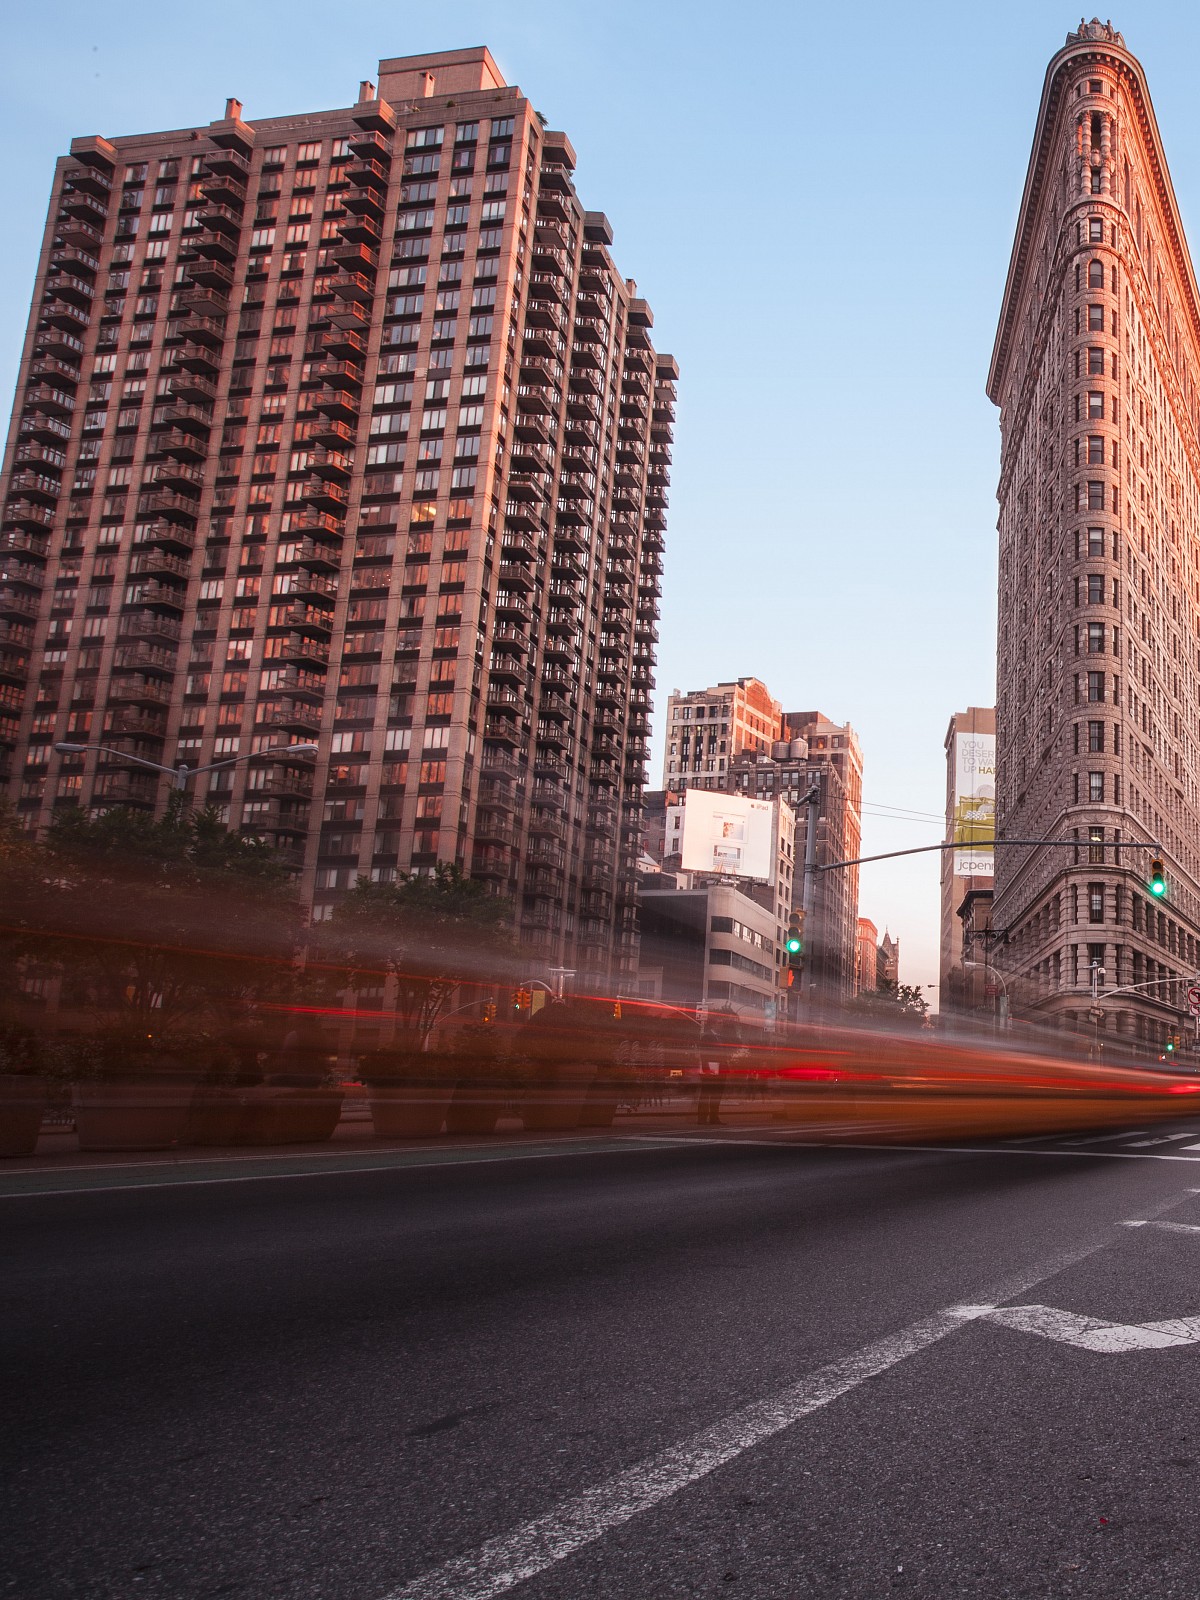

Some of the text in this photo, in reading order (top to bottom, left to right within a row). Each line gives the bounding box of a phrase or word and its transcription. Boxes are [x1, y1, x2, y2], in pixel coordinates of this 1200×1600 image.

[962, 740, 984, 749] YOU
[962, 749, 994, 758] DESER
[962, 757, 975, 766] TO
[963, 766, 977, 774] UP
